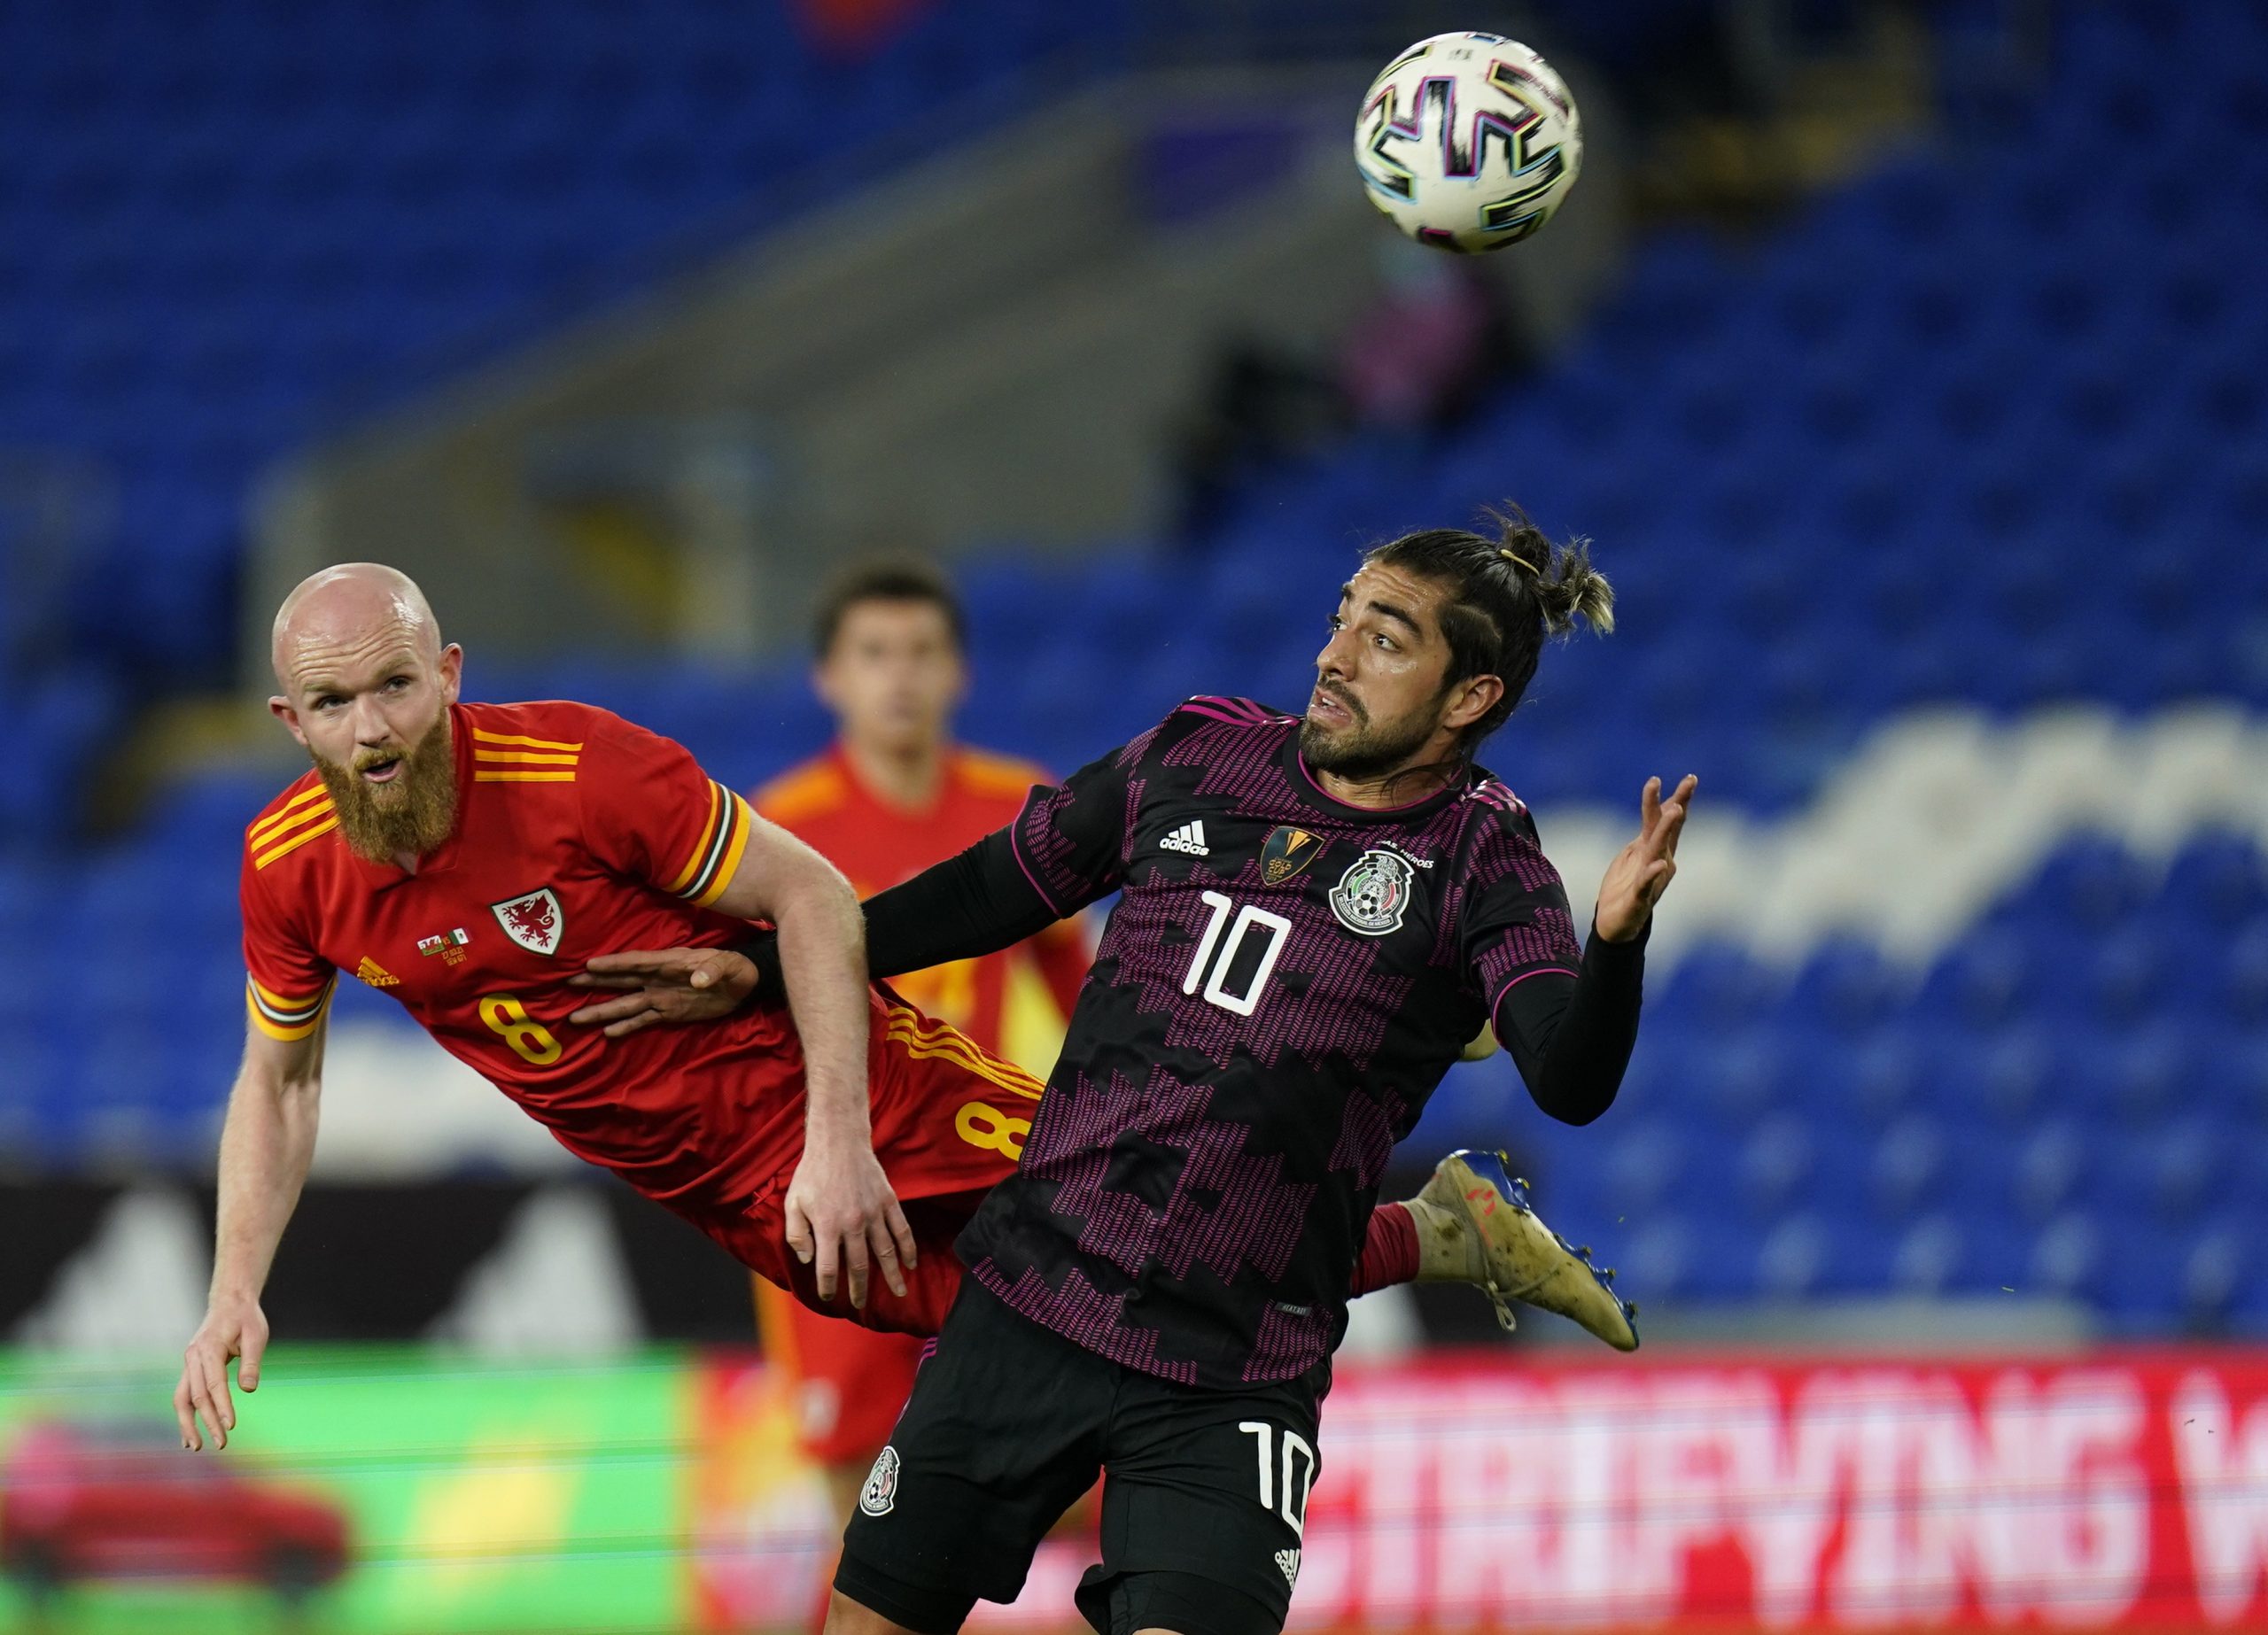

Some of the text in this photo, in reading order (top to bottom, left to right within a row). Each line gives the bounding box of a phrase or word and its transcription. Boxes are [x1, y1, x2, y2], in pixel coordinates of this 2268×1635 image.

[1159, 837, 1210, 856] adidas
[1267, 866, 1286, 875] CUP
[1268, 858, 1293, 871] GOLD
[1182, 889, 1293, 1017] 10
[478, 992, 563, 1065] 8
[955, 1101, 1033, 1162] 8
[1238, 1421, 1316, 1542] 10
